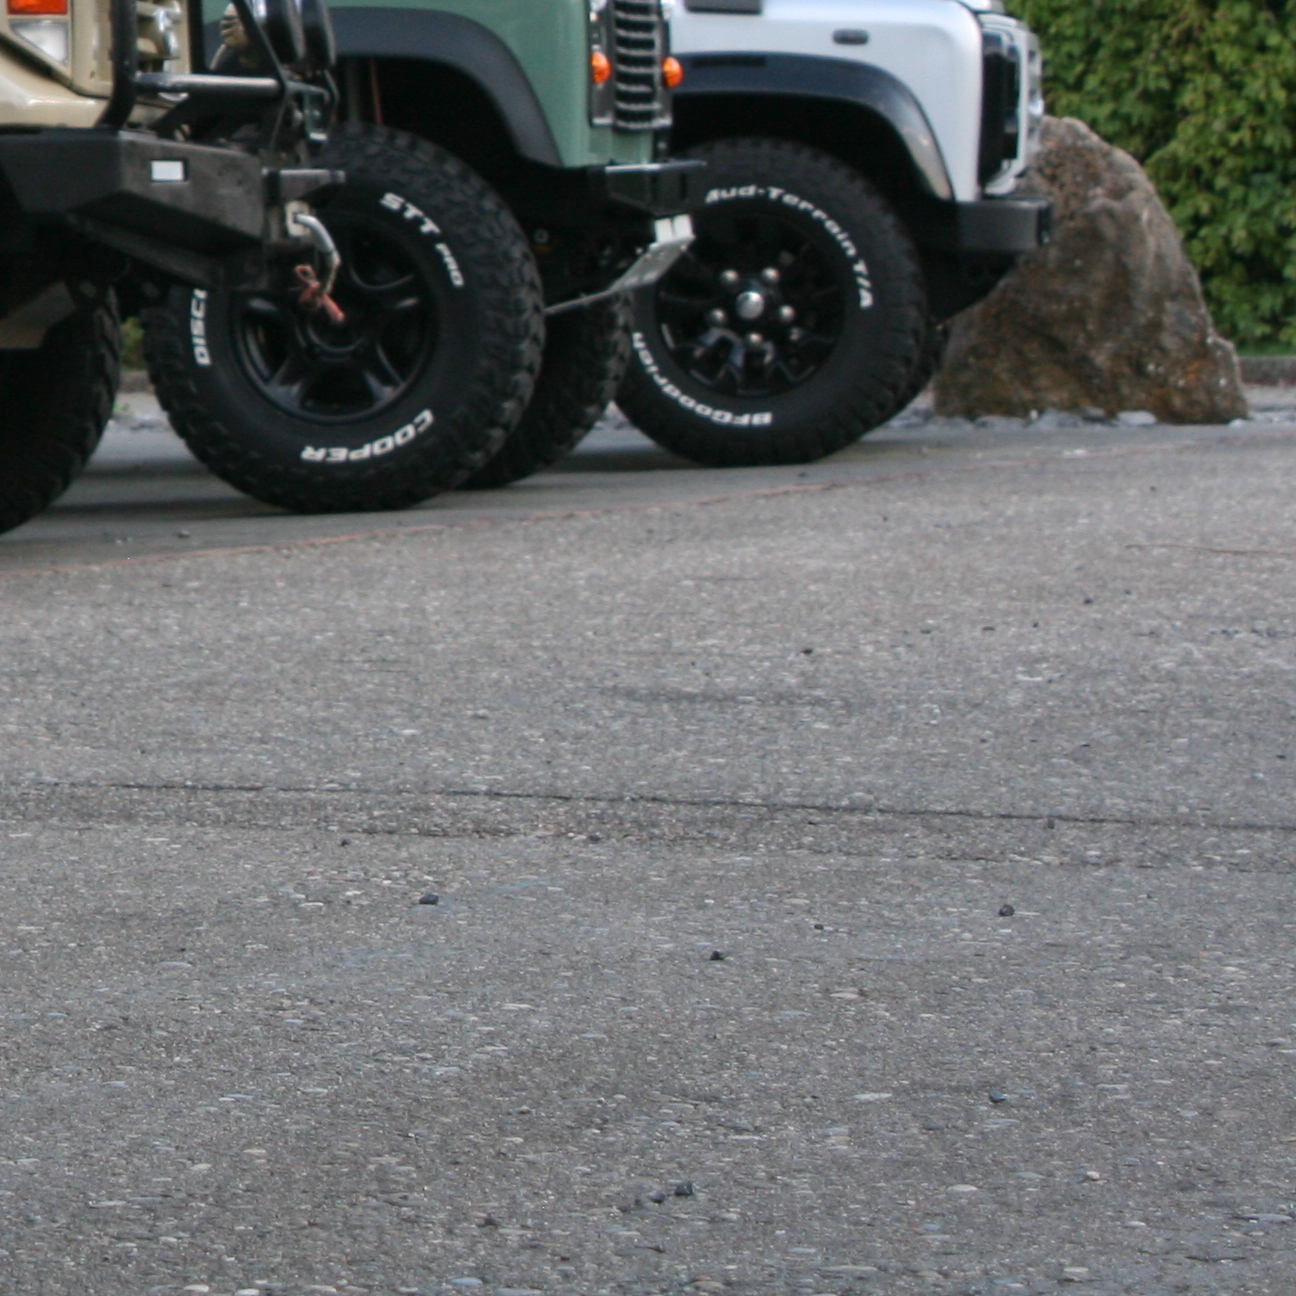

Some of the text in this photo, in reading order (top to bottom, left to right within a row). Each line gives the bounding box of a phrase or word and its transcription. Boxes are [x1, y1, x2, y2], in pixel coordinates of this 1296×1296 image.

[378, 192, 467, 289] STT PRO
[300, 408, 436, 464] COOPER
